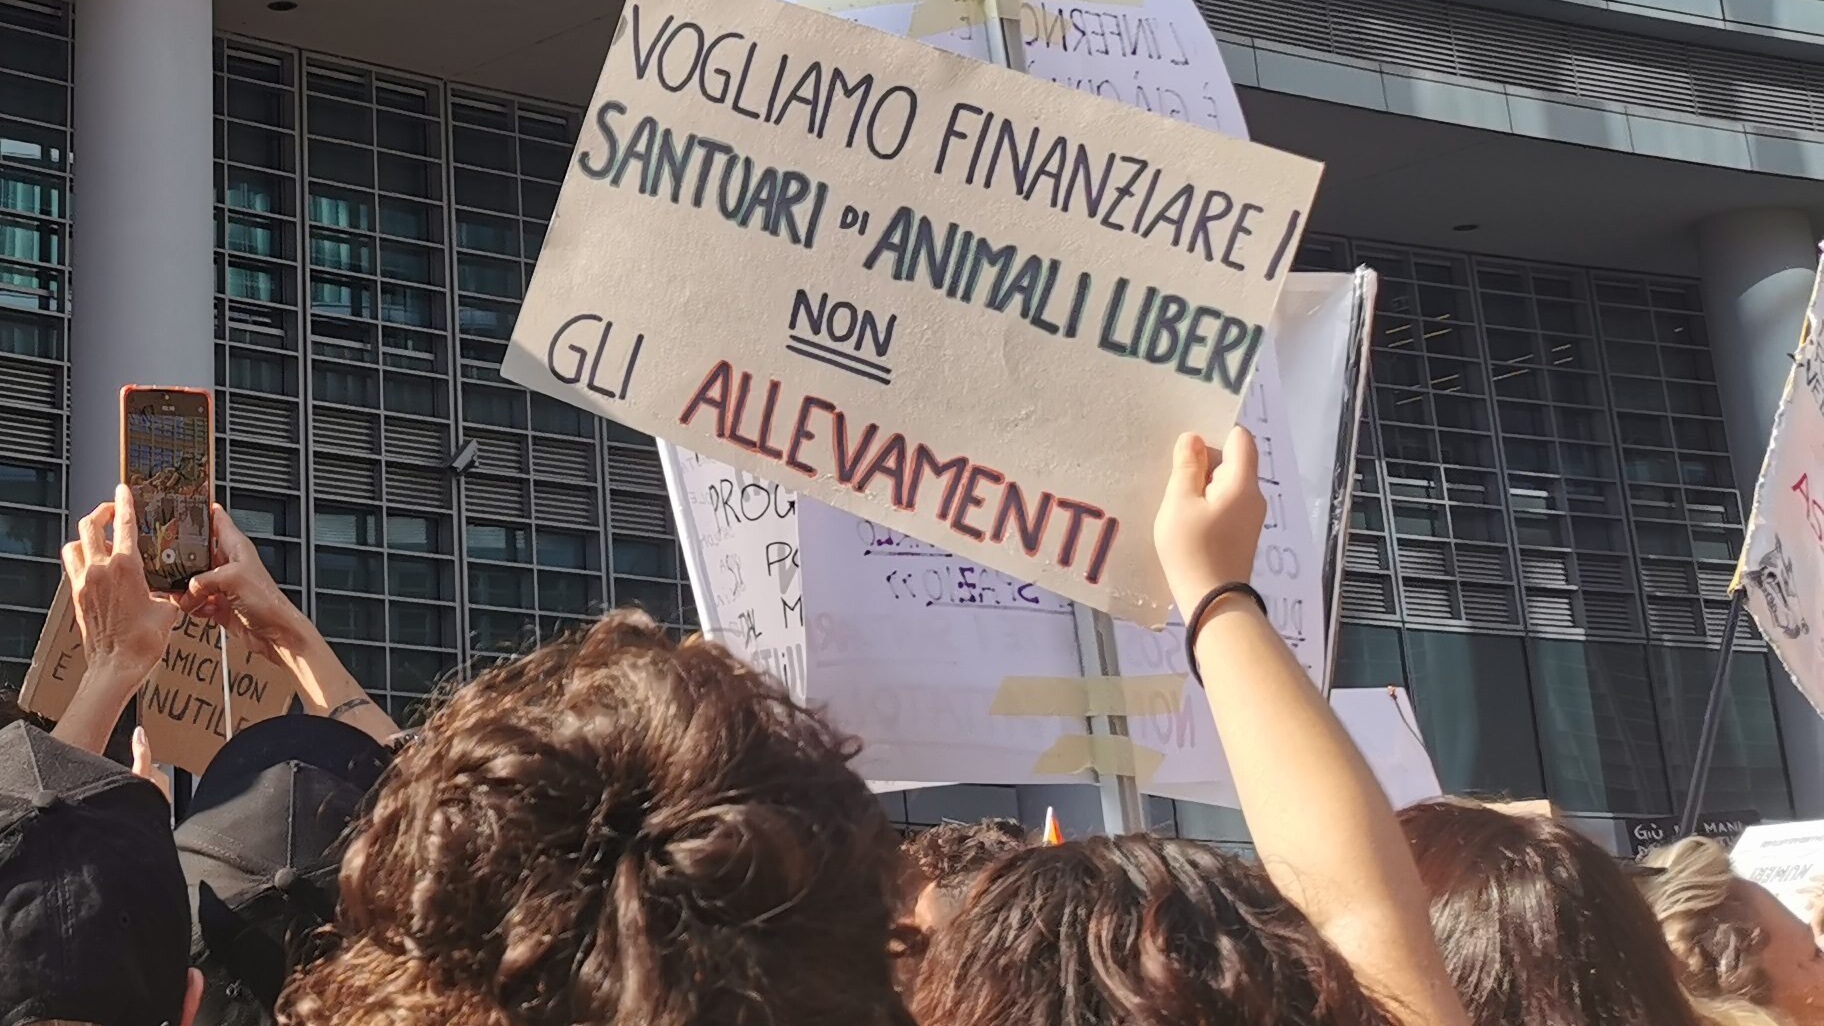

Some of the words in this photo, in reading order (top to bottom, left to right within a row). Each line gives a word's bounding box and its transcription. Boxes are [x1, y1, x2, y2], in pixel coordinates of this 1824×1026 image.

[578, 100, 829, 249] SANTUARI
[839, 205, 870, 235] DI
[862, 205, 1092, 339] ANIMALI
[1097, 277, 1264, 395] LIBERI
[633, 4, 918, 160] VOGLIAMO
[934, 102, 1264, 271] FINANZIARE
[547, 313, 644, 400] GLI
[679, 359, 1119, 585] ALLEVAMENTI
[788, 288, 897, 358] NON
